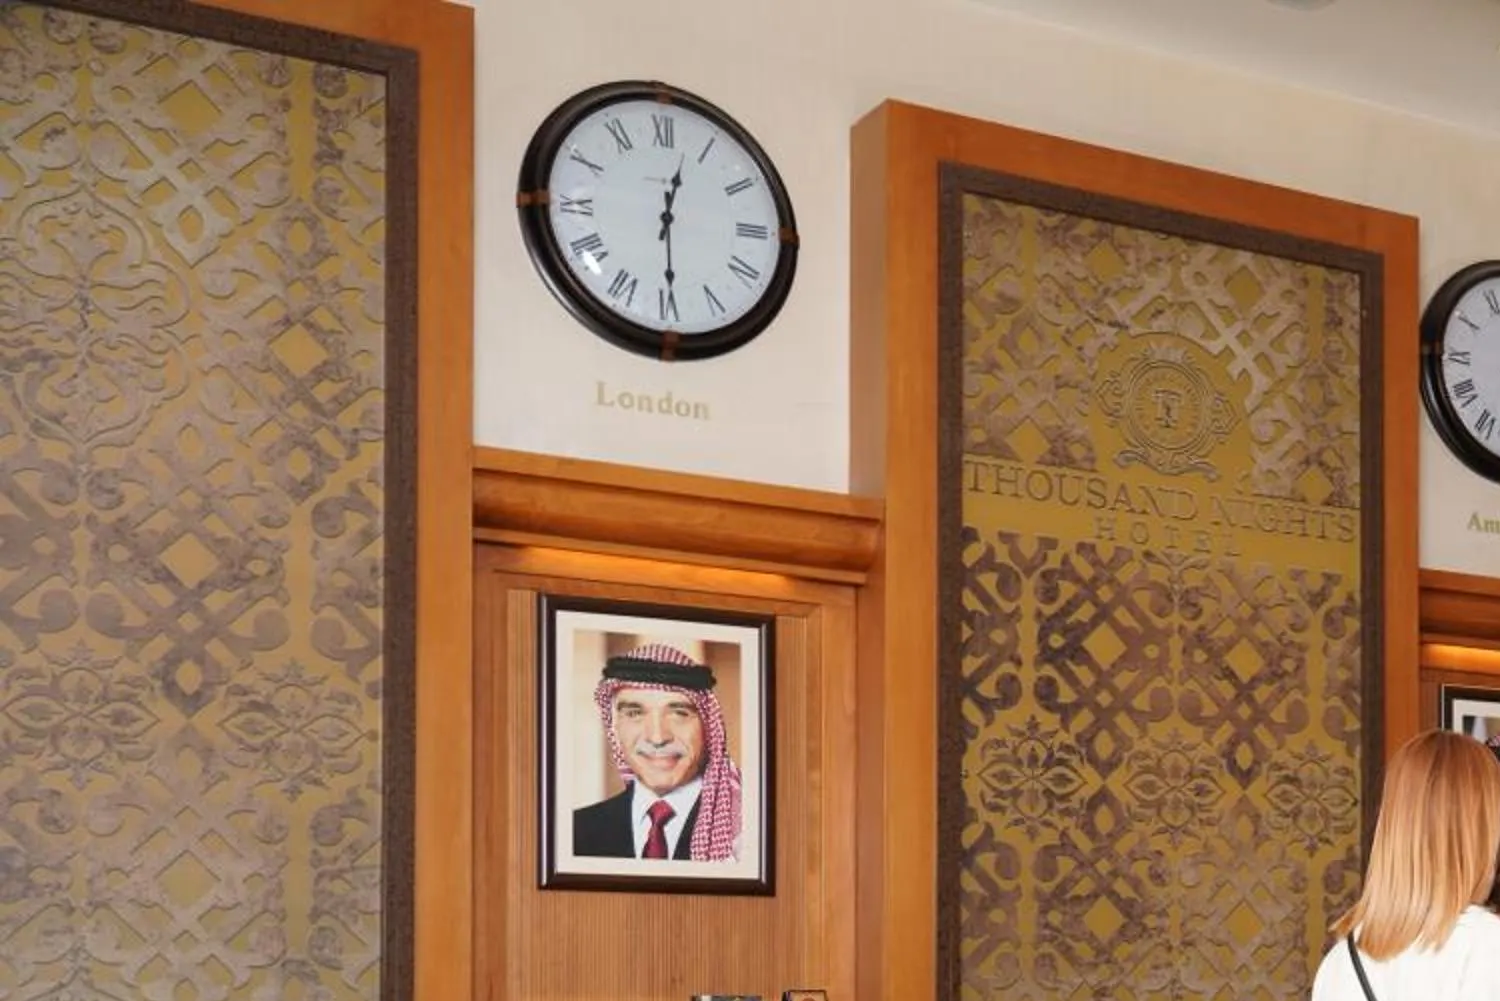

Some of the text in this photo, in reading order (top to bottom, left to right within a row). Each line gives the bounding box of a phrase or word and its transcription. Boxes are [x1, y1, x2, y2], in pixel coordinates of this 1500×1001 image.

[604, 118, 632, 152] XI
[651, 114, 675, 149] XII
[569, 149, 604, 175] X
[698, 136, 715, 165] I
[724, 177, 754, 196] II
[559, 194, 594, 216] IX
[735, 222, 769, 240] III
[607, 269, 639, 308] VII
[727, 255, 761, 289] IV
[658, 287, 680, 322] VI
[702, 284, 726, 317] V
[594, 380, 712, 421] London
[964, 460, 1357, 544] THOUSAND NIGHTS
[1091, 516, 1243, 557] HOTEL
